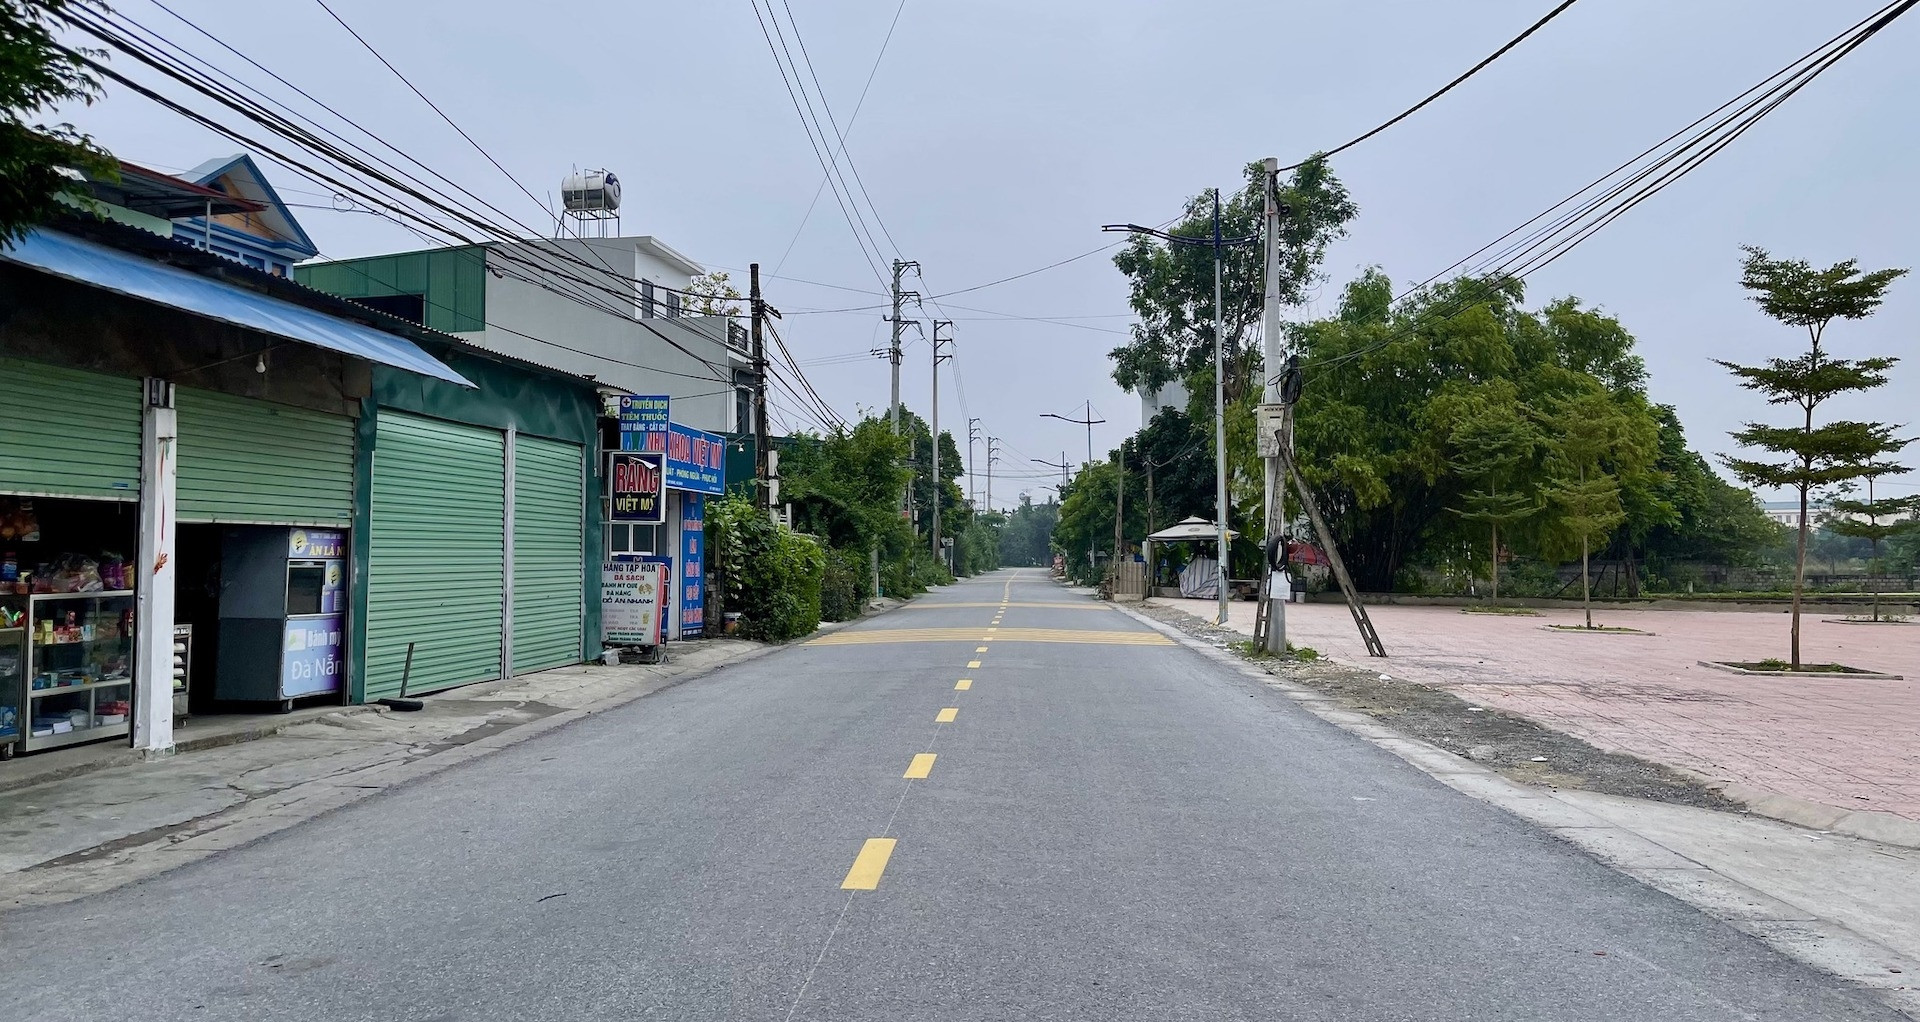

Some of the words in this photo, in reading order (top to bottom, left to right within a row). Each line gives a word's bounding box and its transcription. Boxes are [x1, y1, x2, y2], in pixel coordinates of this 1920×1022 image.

[668, 431, 691, 464] KHOA
[693, 434, 710, 472] VIỆT
[616, 494, 638, 512] VIỆT
[291, 659, 311, 680] Đà
